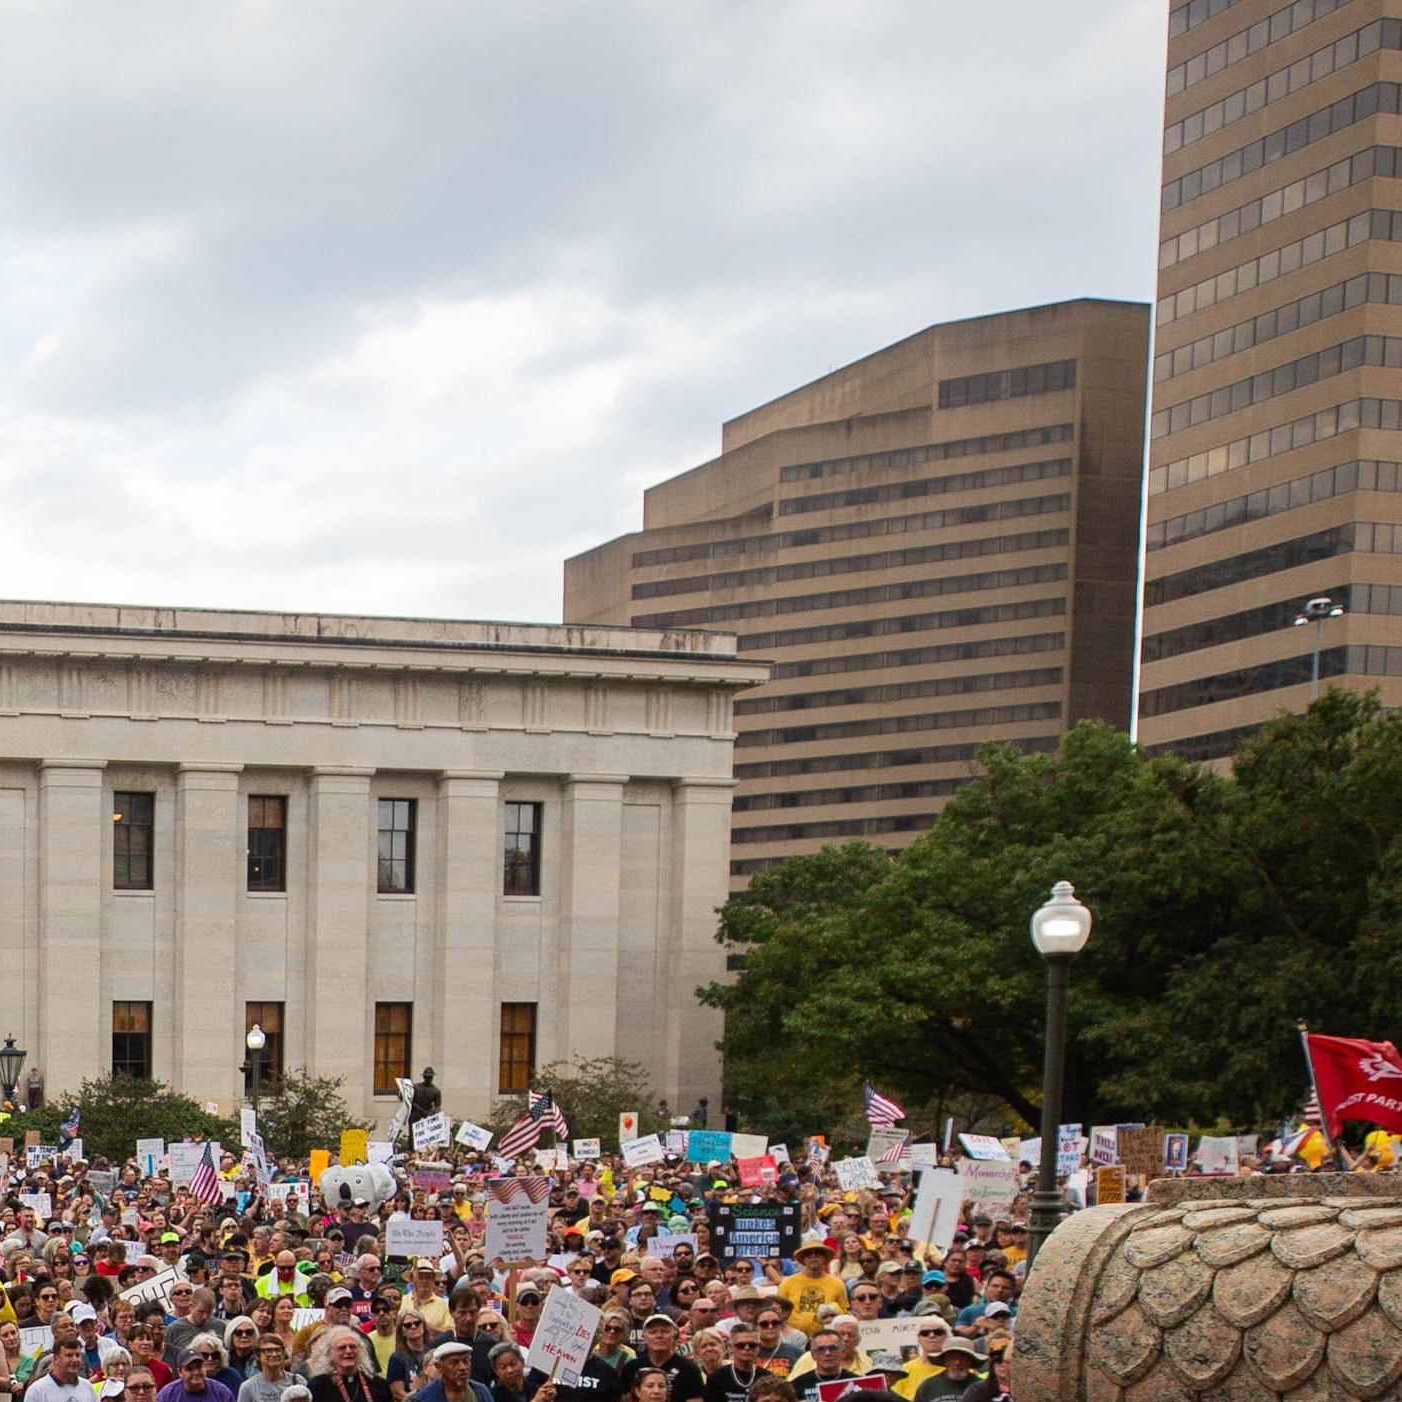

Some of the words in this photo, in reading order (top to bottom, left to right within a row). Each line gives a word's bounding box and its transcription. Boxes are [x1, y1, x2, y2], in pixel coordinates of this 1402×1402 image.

[1365, 1092, 1402, 1112] PART
[731, 1203, 783, 1218] Science
[736, 1218, 776, 1230] makes
[729, 1231, 781, 1244] America
[736, 1244, 769, 1258] great
[541, 1340, 577, 1364] HEAVEN
